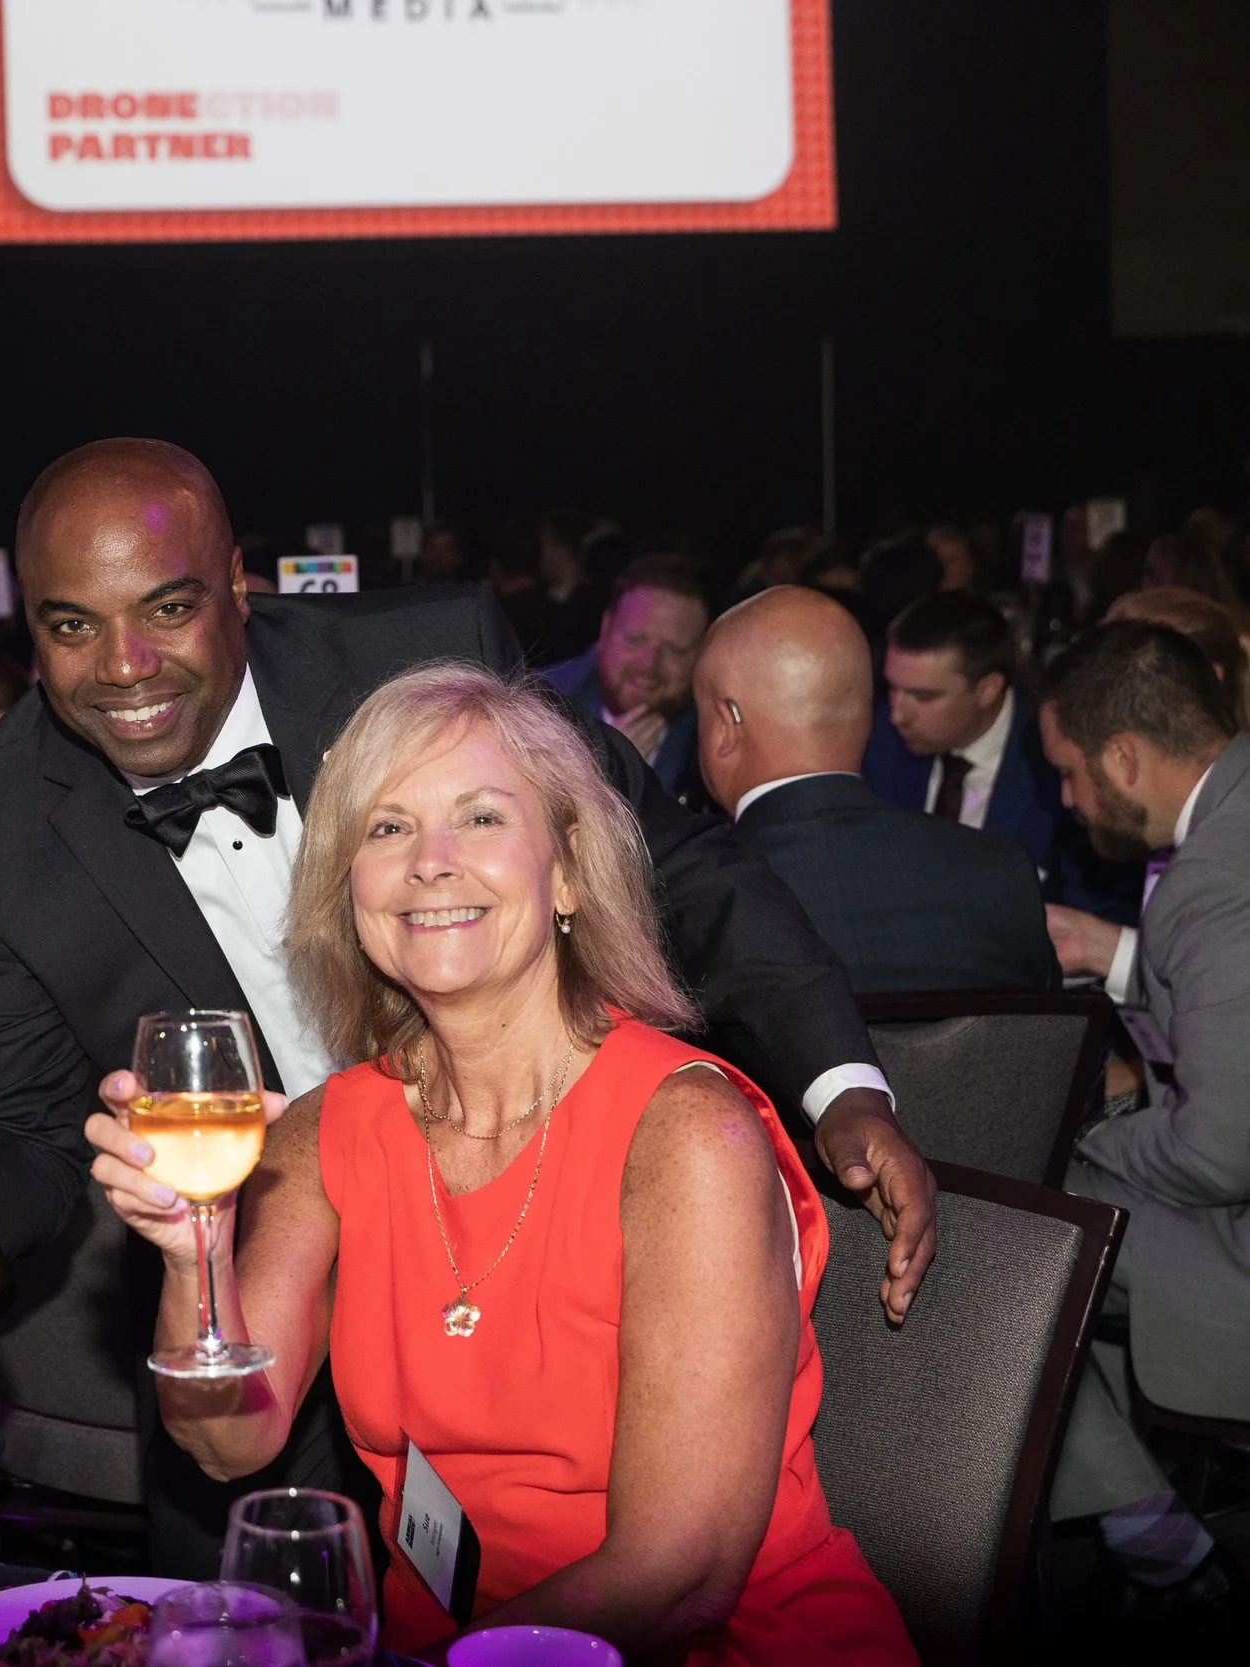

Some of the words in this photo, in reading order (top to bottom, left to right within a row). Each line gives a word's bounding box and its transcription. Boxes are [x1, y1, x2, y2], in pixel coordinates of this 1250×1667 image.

[323, 0, 494, 22] MEDIA
[49, 132, 252, 160] PARTNER
[422, 1513, 430, 1534] Sue
